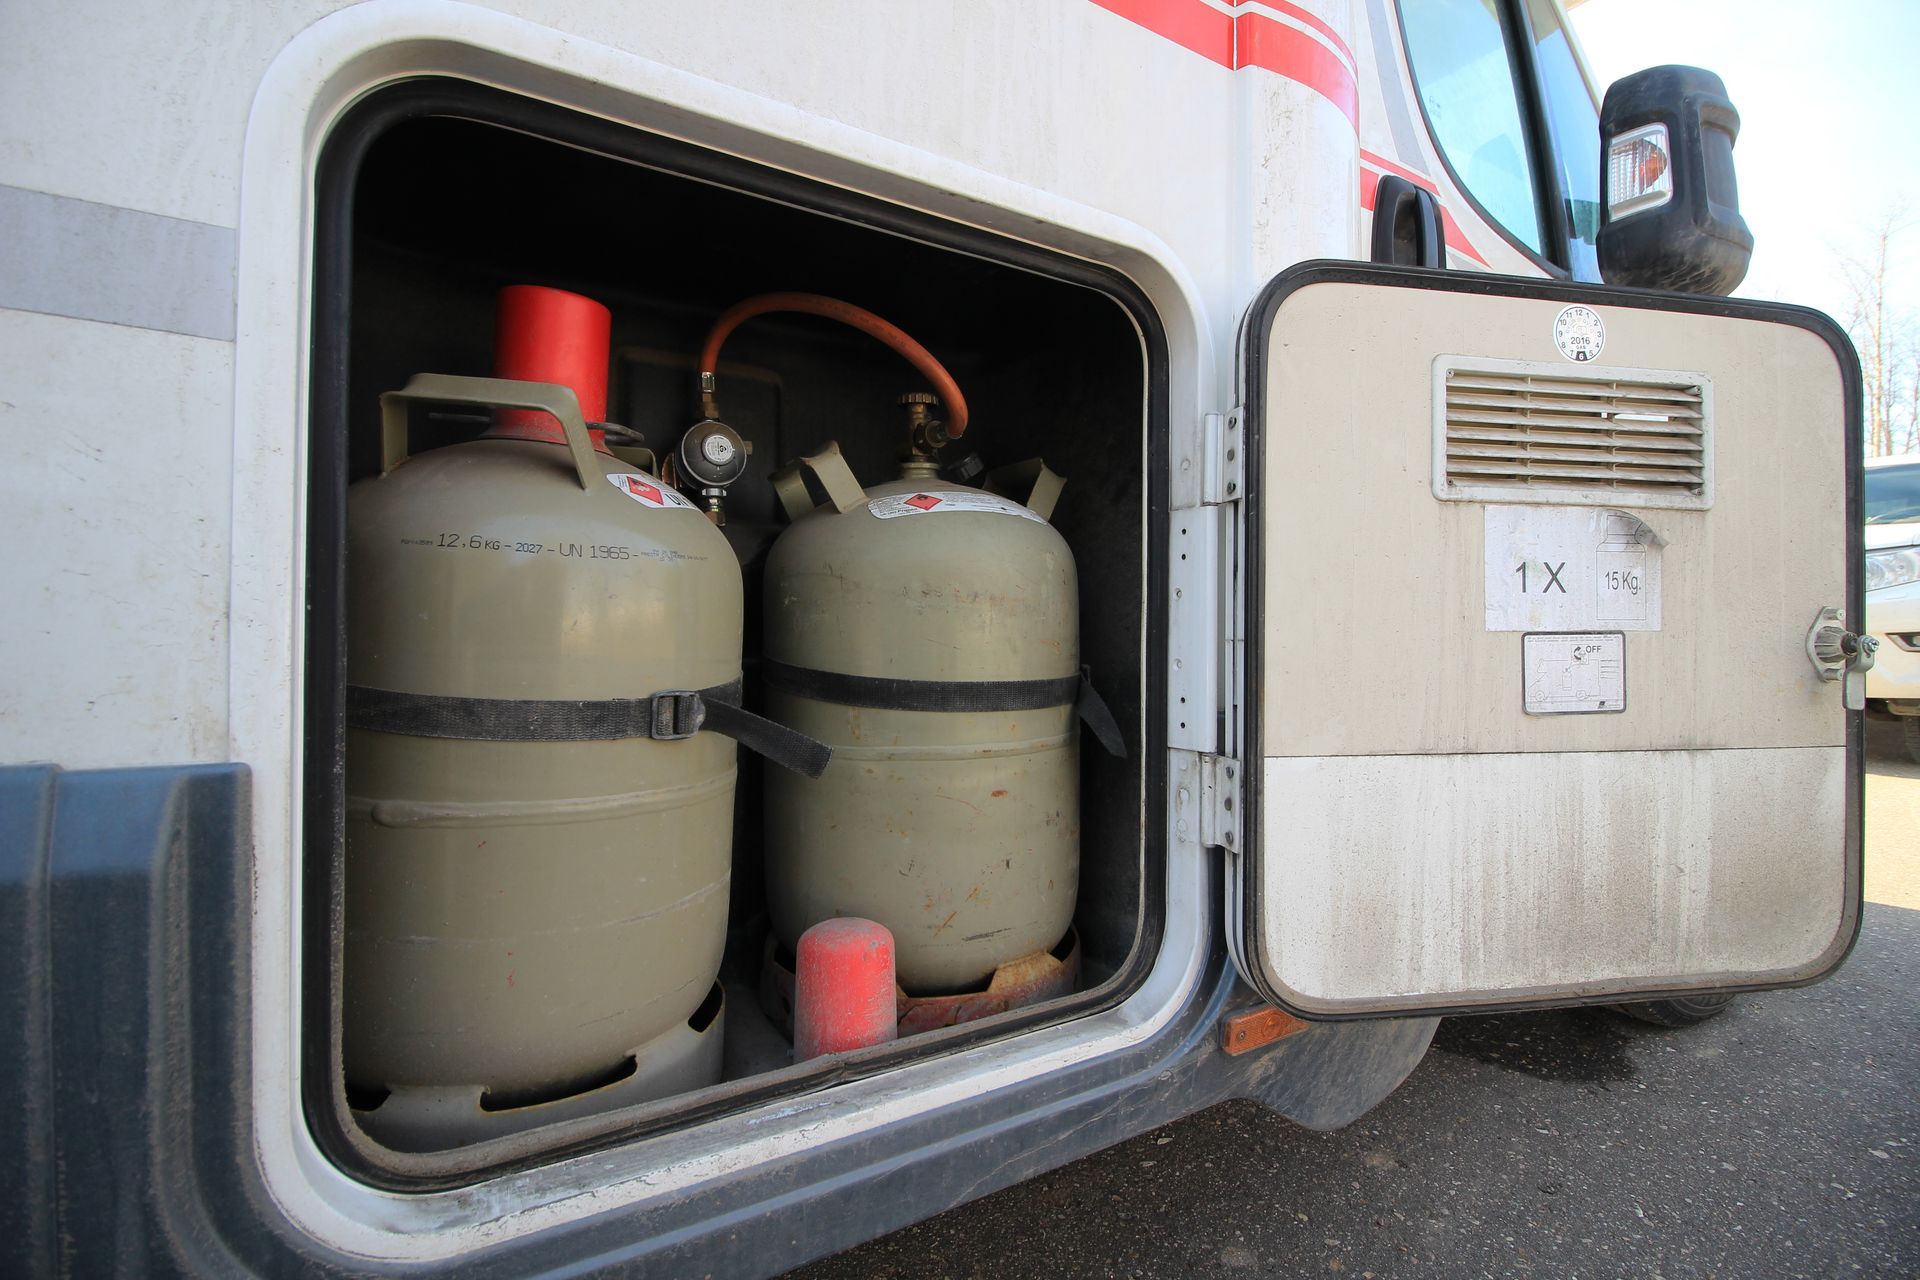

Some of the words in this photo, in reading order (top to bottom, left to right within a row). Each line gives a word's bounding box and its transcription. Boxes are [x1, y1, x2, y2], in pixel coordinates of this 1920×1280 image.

[515, 542, 543, 554] 2027
[559, 543, 582, 558] UN
[590, 545, 630, 560] 1965
[1515, 561, 1527, 593] 1
[1542, 561, 1567, 594] X
[1585, 645, 1602, 654] OFF
